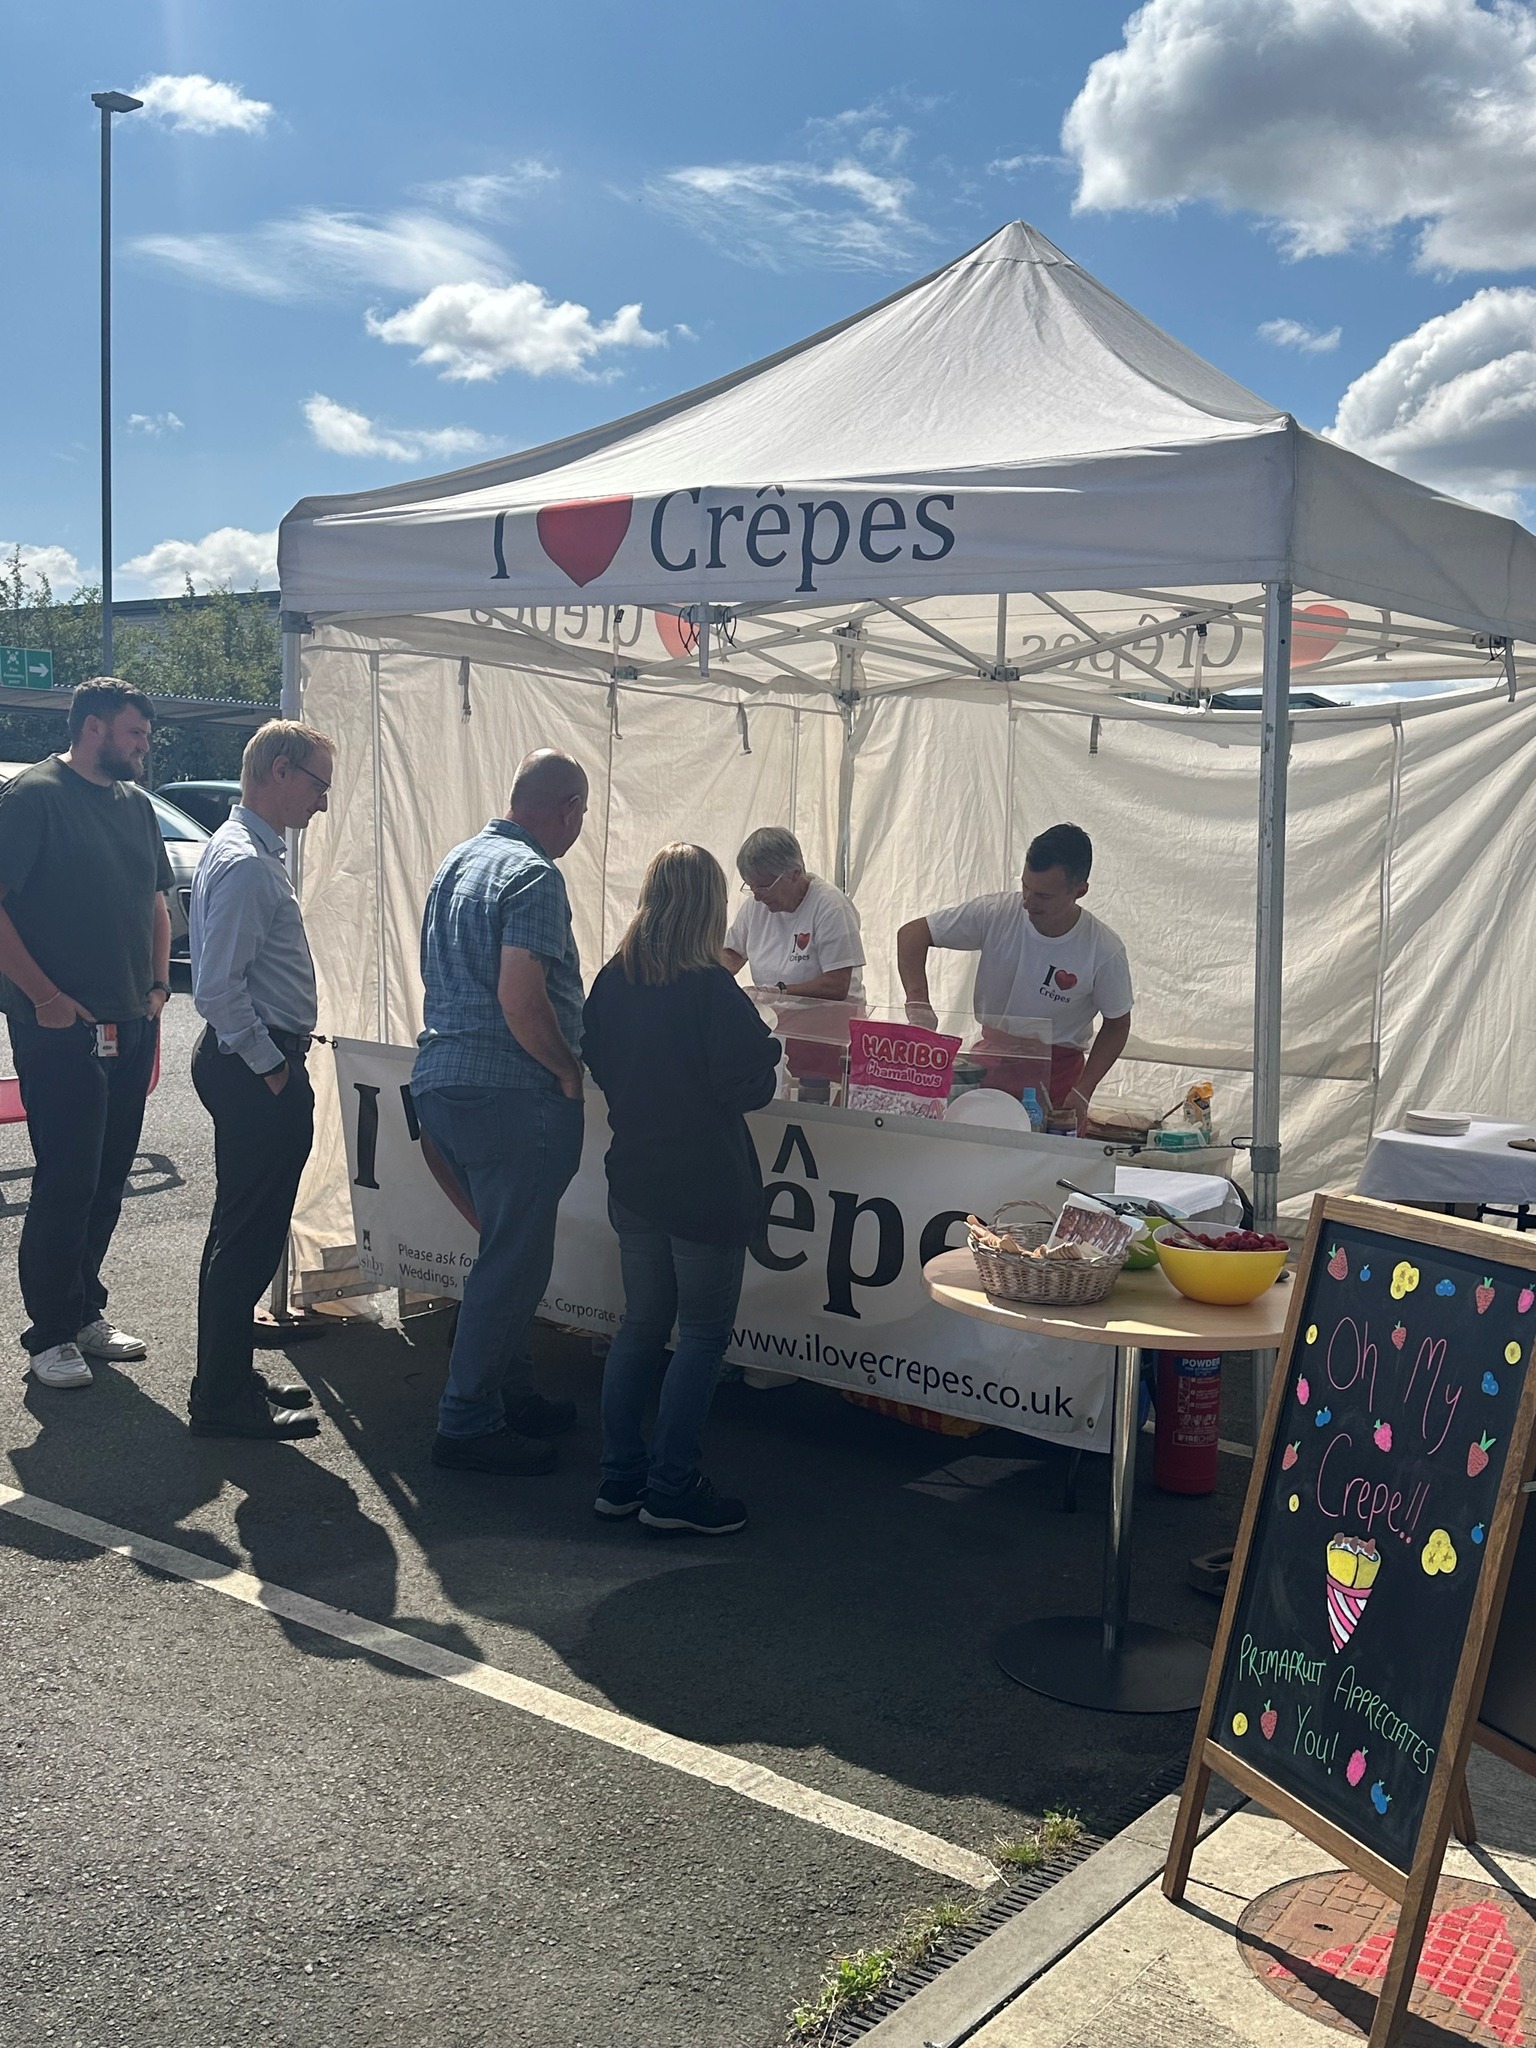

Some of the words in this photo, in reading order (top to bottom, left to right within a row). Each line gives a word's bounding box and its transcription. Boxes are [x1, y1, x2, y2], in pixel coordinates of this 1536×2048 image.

[490, 510, 510, 580] I
[650, 484, 956, 593] Crêpes
[1042, 964, 1057, 987] I
[1039, 986, 1072, 1004] Crêpes
[862, 1033, 949, 1070] HARIBO
[866, 1058, 943, 1089] Chamallows
[354, 1083, 380, 1190] I
[359, 1253, 385, 1277] shby
[398, 1243, 433, 1262] Please
[435, 1251, 456, 1266] ask
[399, 1263, 458, 1288] Weddings,
[555, 1297, 616, 1323] Corporate
[728, 1327, 1075, 1419] www.ilovecrepes.co.uk
[1181, 1357, 1221, 1367] POWDER
[1326, 1316, 1378, 1413] Oh
[1403, 1335, 1463, 1456] My
[1317, 1432, 1430, 1544] Crepe!!
[1238, 1633, 1327, 1688] PRIMAFRUIT
